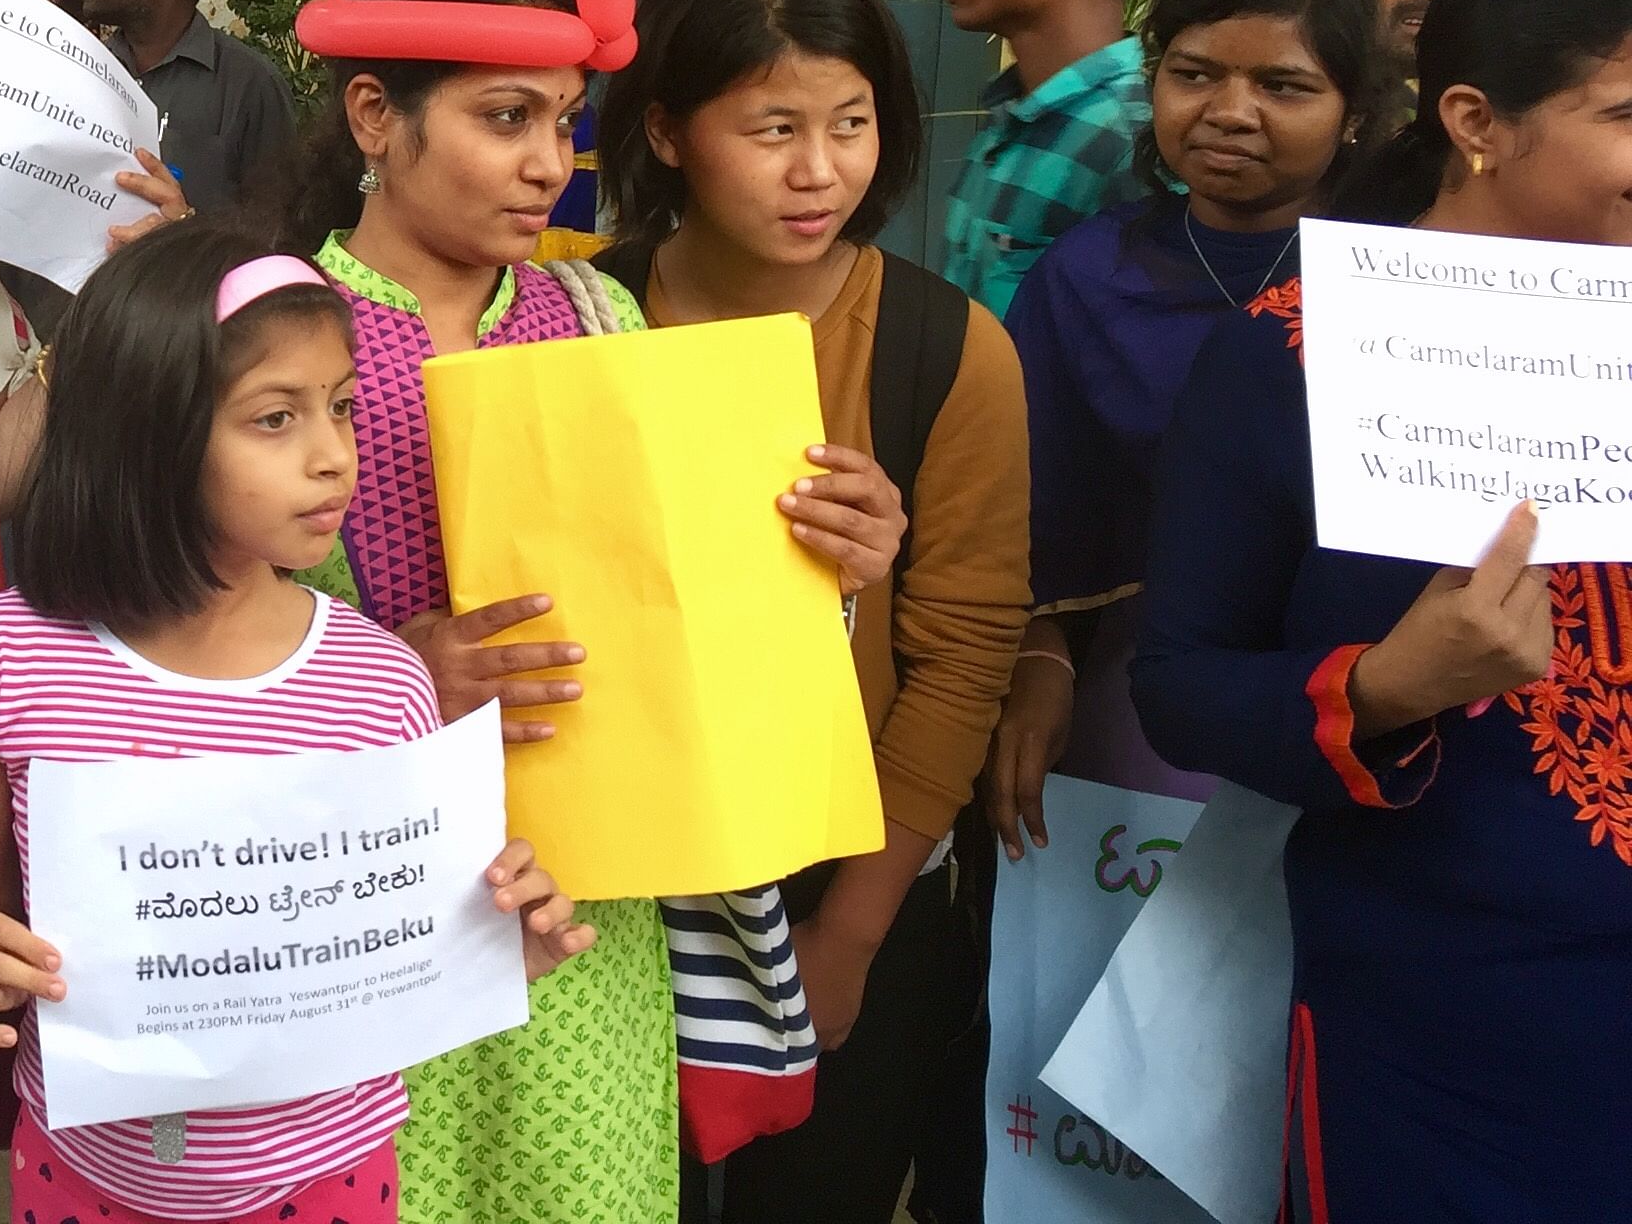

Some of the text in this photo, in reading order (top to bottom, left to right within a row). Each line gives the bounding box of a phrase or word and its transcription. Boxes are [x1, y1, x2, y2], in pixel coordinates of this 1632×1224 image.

[20, 14, 39, 36] to
[46, 26, 138, 113] Carmelaram
[1351, 246, 1497, 288] Welcome
[1509, 268, 1538, 291] to
[119, 845, 127, 871] I
[236, 832, 329, 866] drive!
[341, 831, 349, 855] I
[359, 807, 440, 852] train!
[136, 916, 434, 981] #ModaluTrainBeku
[136, 1021, 179, 1035] Begins
[182, 1019, 194, 1032] at
[198, 1015, 243, 1030] 230PM
[247, 1011, 285, 1025] Friday
[289, 1004, 332, 1020] August
[361, 992, 374, 1005] @
[377, 970, 442, 999] Yeswantpur
[146, 1003, 171, 1016] Join
[174, 1004, 189, 1014] us
[192, 1003, 208, 1013] on
[212, 1001, 220, 1010] a
[223, 997, 247, 1010] Rail
[250, 995, 282, 1008] Yatra
[289, 981, 361, 1002] Yeswantpur
[364, 975, 377, 987] to
